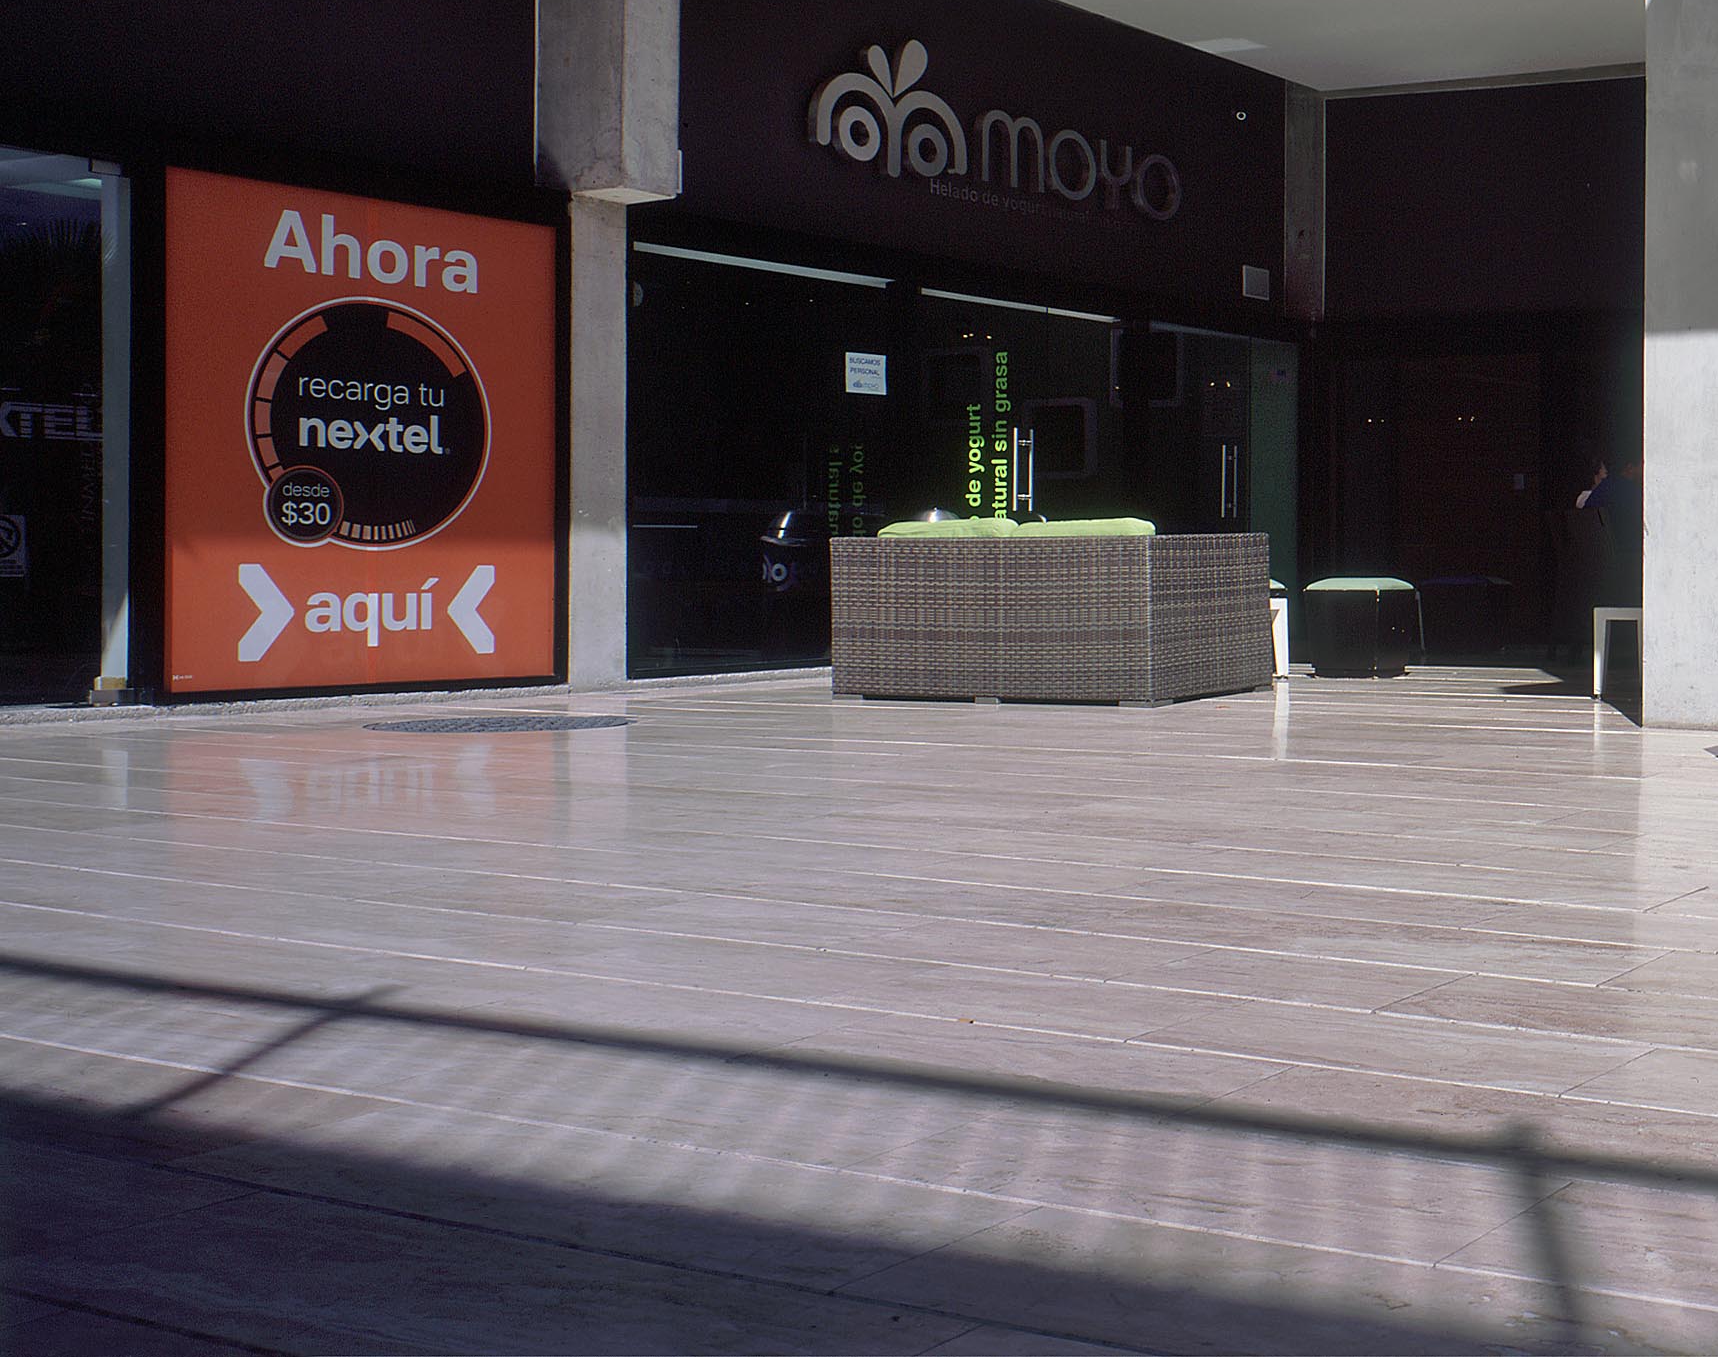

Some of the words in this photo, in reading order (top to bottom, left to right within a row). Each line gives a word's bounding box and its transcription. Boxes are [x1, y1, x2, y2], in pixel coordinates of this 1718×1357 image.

[929, 177, 978, 204] Helado
[982, 191, 999, 207] de
[263, 209, 480, 294] Ahora
[298, 374, 410, 411] recarga
[418, 381, 445, 407] tu
[994, 351, 1011, 413] grasa
[298, 414, 444, 456] nextel
[966, 403, 986, 474] yogurt
[991, 419, 1008, 452] sin
[281, 480, 330, 499] desde
[964, 479, 982, 508] de
[991, 458, 1008, 520] atural
[280, 501, 332, 530] $30
[304, 577, 439, 648] aquí
